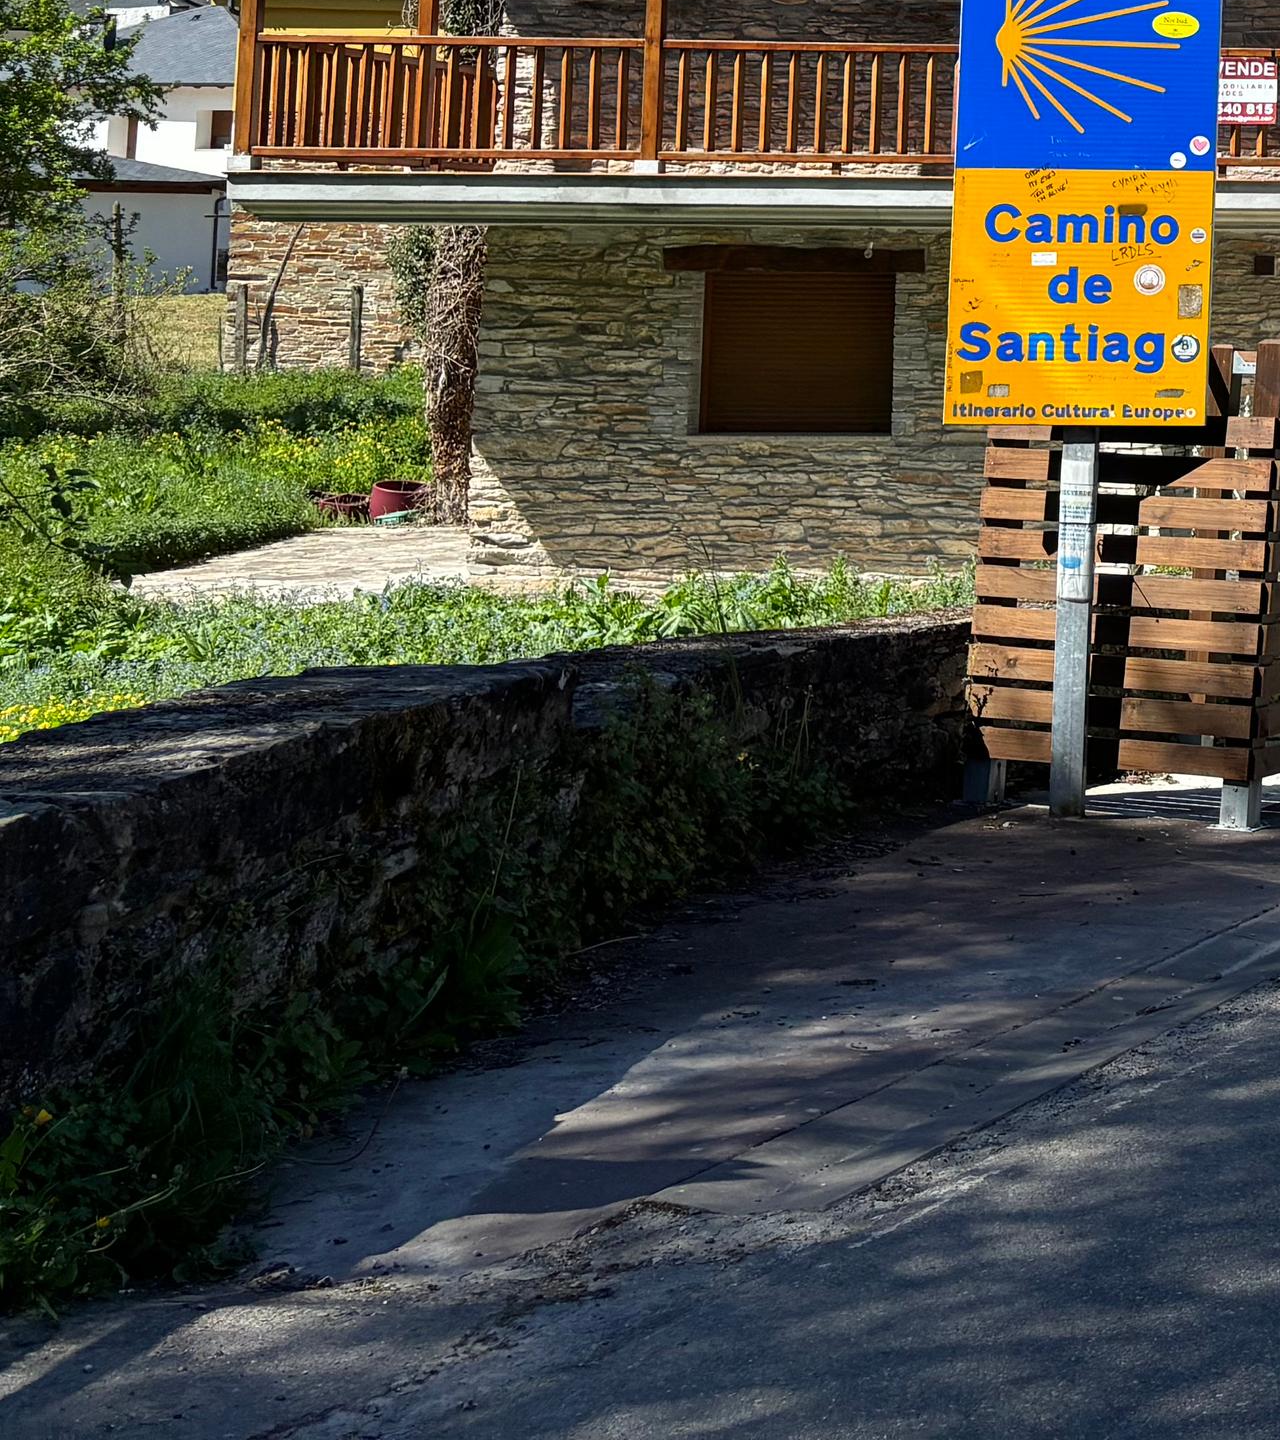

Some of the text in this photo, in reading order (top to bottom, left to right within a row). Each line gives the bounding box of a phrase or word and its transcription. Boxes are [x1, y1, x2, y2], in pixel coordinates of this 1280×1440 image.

[1246, 103, 1274, 115] 815
[1048, 266, 1113, 305] de
[956, 321, 1166, 374] Santiag
